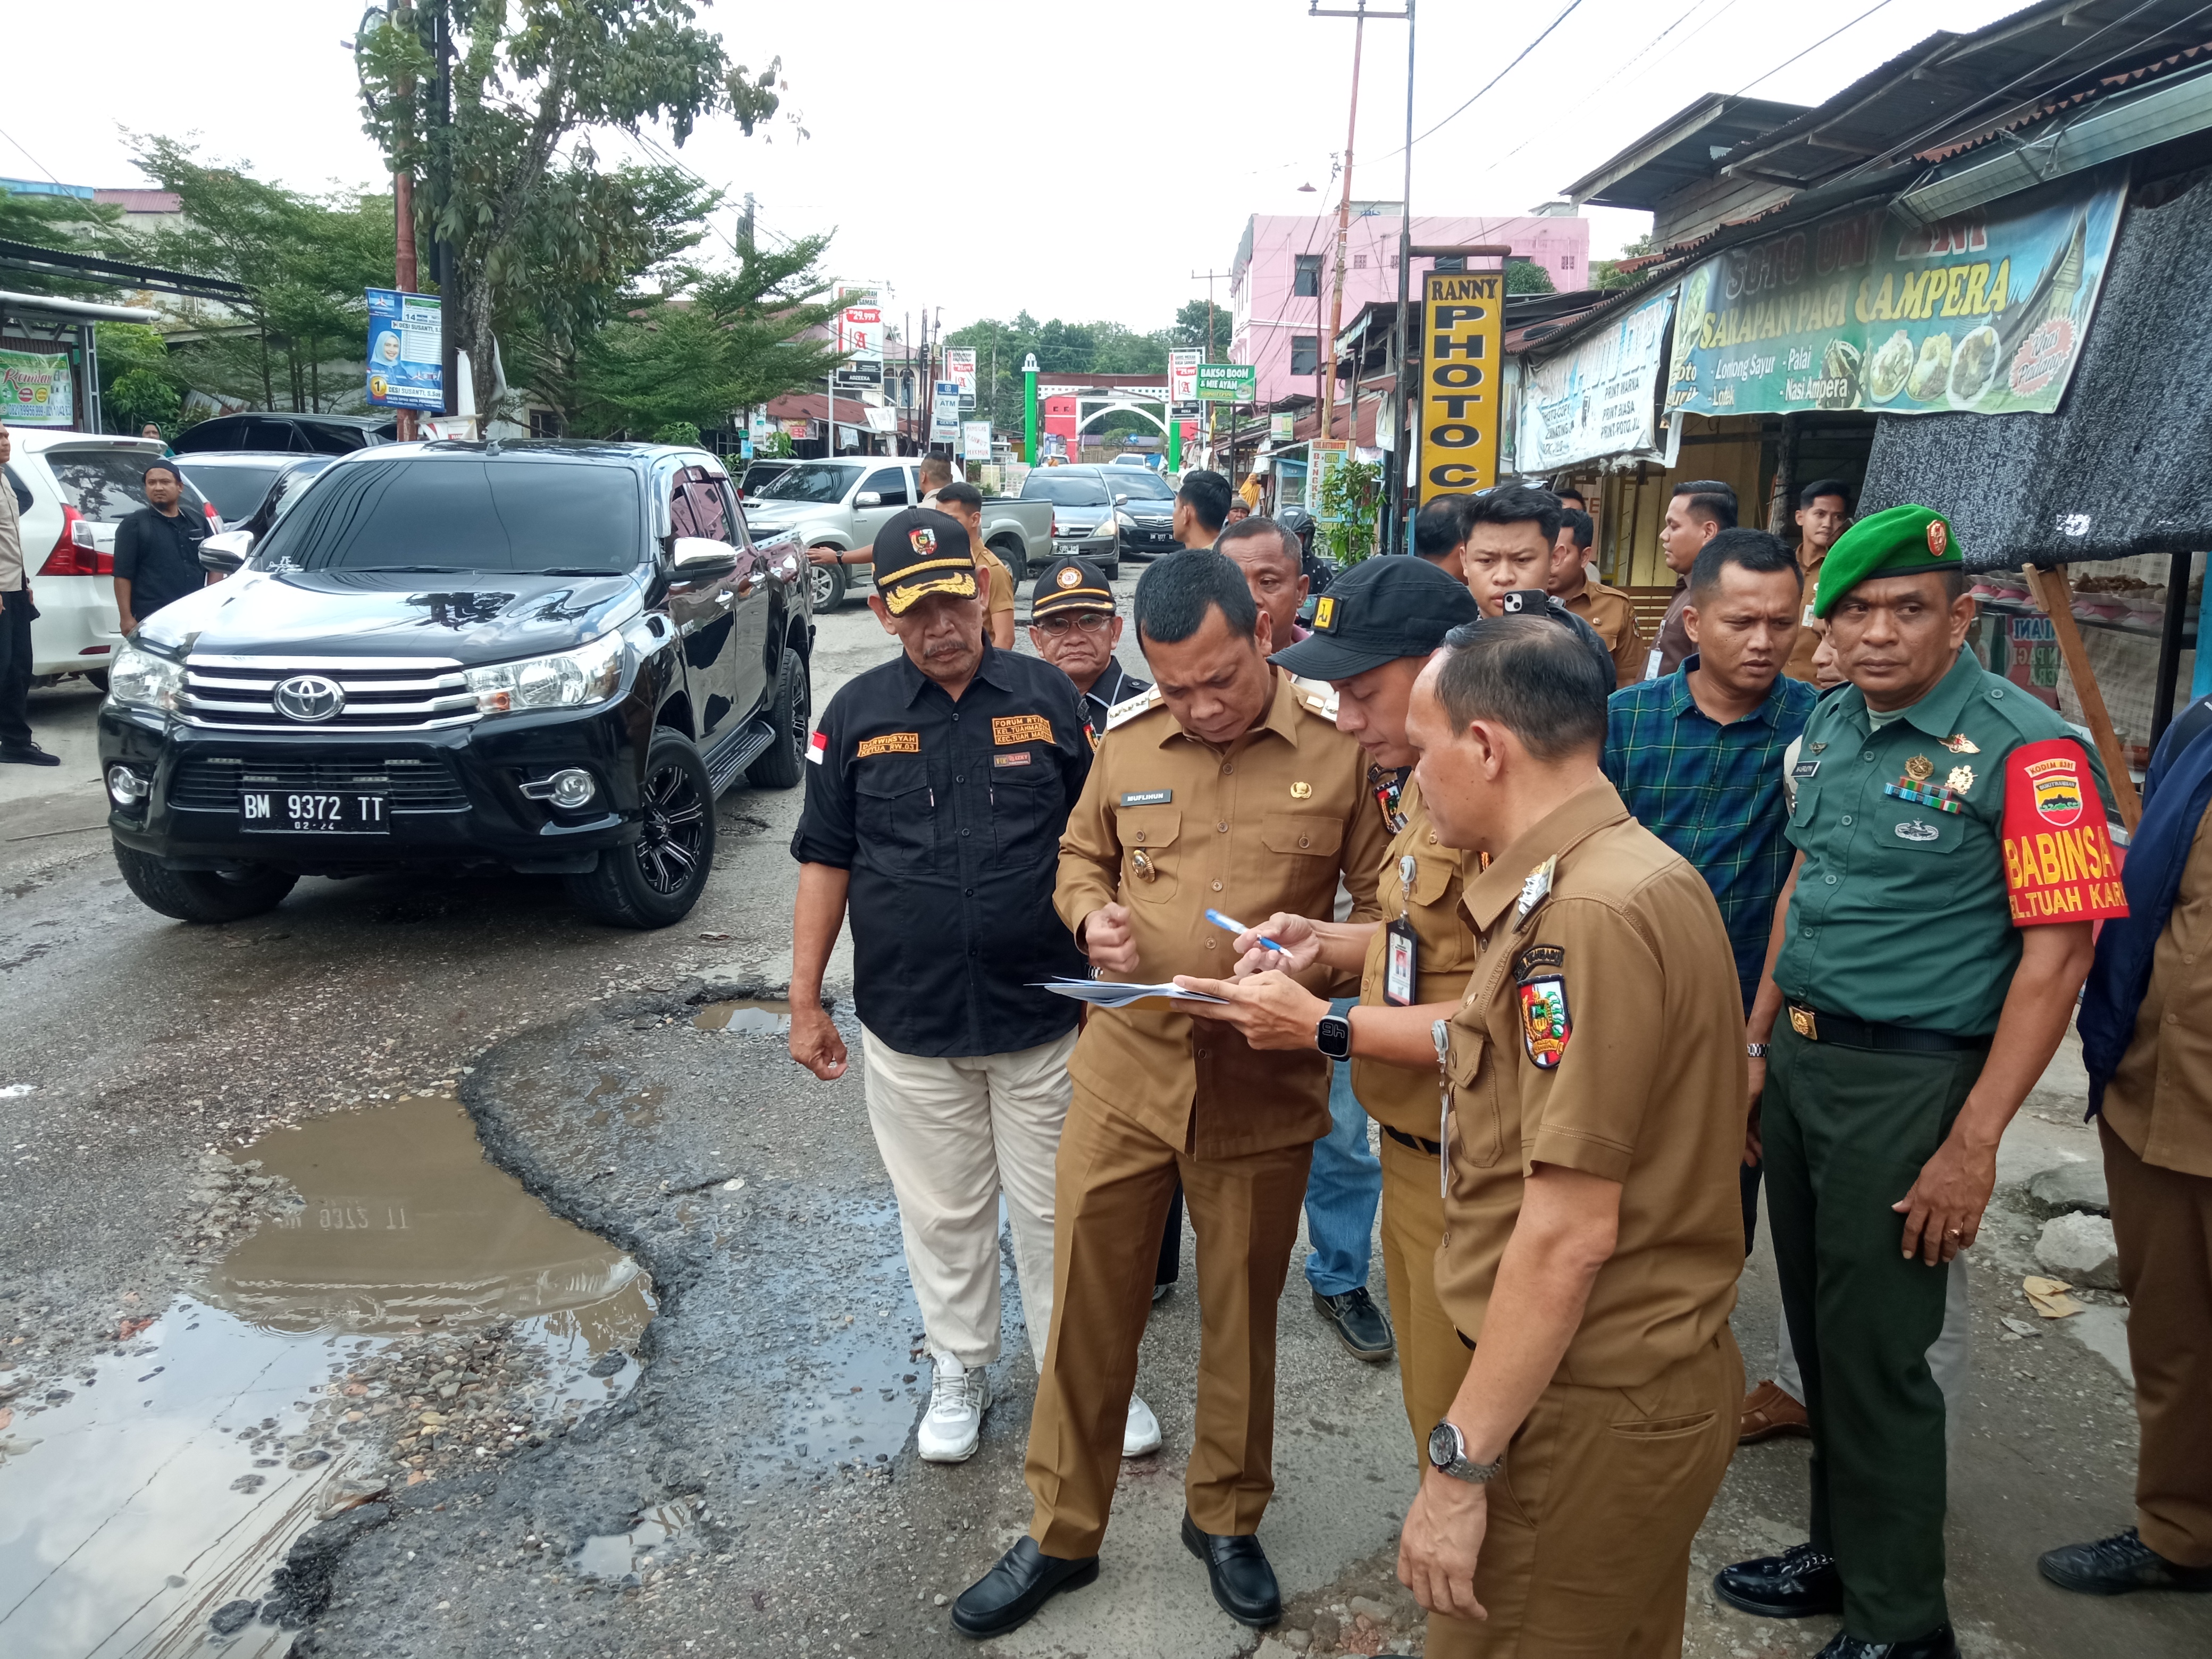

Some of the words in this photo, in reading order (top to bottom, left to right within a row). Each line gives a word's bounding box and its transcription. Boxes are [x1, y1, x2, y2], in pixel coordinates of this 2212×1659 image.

[1431, 279, 1498, 300] RANNY
[853, 311, 876, 321] 29.999
[1699, 295, 1795, 349] SARAPAN
[1795, 281, 1849, 333] PAGI
[411, 323, 434, 333] SUSANTI,
[2031, 326, 2059, 358] Khas
[1749, 353, 1775, 380] Sayur
[1787, 346, 1812, 372] Palai
[2018, 350, 2062, 387] Padang
[1200, 368, 1226, 378] BAKSO
[1226, 368, 1249, 379] BOOM
[1429, 305, 1487, 449] PHOTO
[374, 380, 380, 392] 1
[401, 388, 426, 397] SUSANTI,
[1206, 380, 1218, 388] MIE
[1218, 380, 1237, 390] AYAM
[1604, 382, 1620, 401] PRINT
[1620, 376, 1639, 395] WARNA
[1784, 376, 1806, 401] Nasi
[1806, 378, 1848, 405] Ampera
[1311, 453, 1320, 508] BENGKEL
[995, 718, 1023, 727] FORUM
[862, 735, 915, 750] DARWINSYAH
[997, 733, 1029, 743] KEC.TUAH
[861, 745, 885, 755] KETUA
[2029, 761, 2056, 775] KODIM
[1127, 793, 1163, 802] MUFLIHUN
[244, 794, 270, 818] BM
[288, 794, 341, 820] 9372
[357, 797, 383, 820] TT
[2004, 825, 2116, 889] BABINSA
